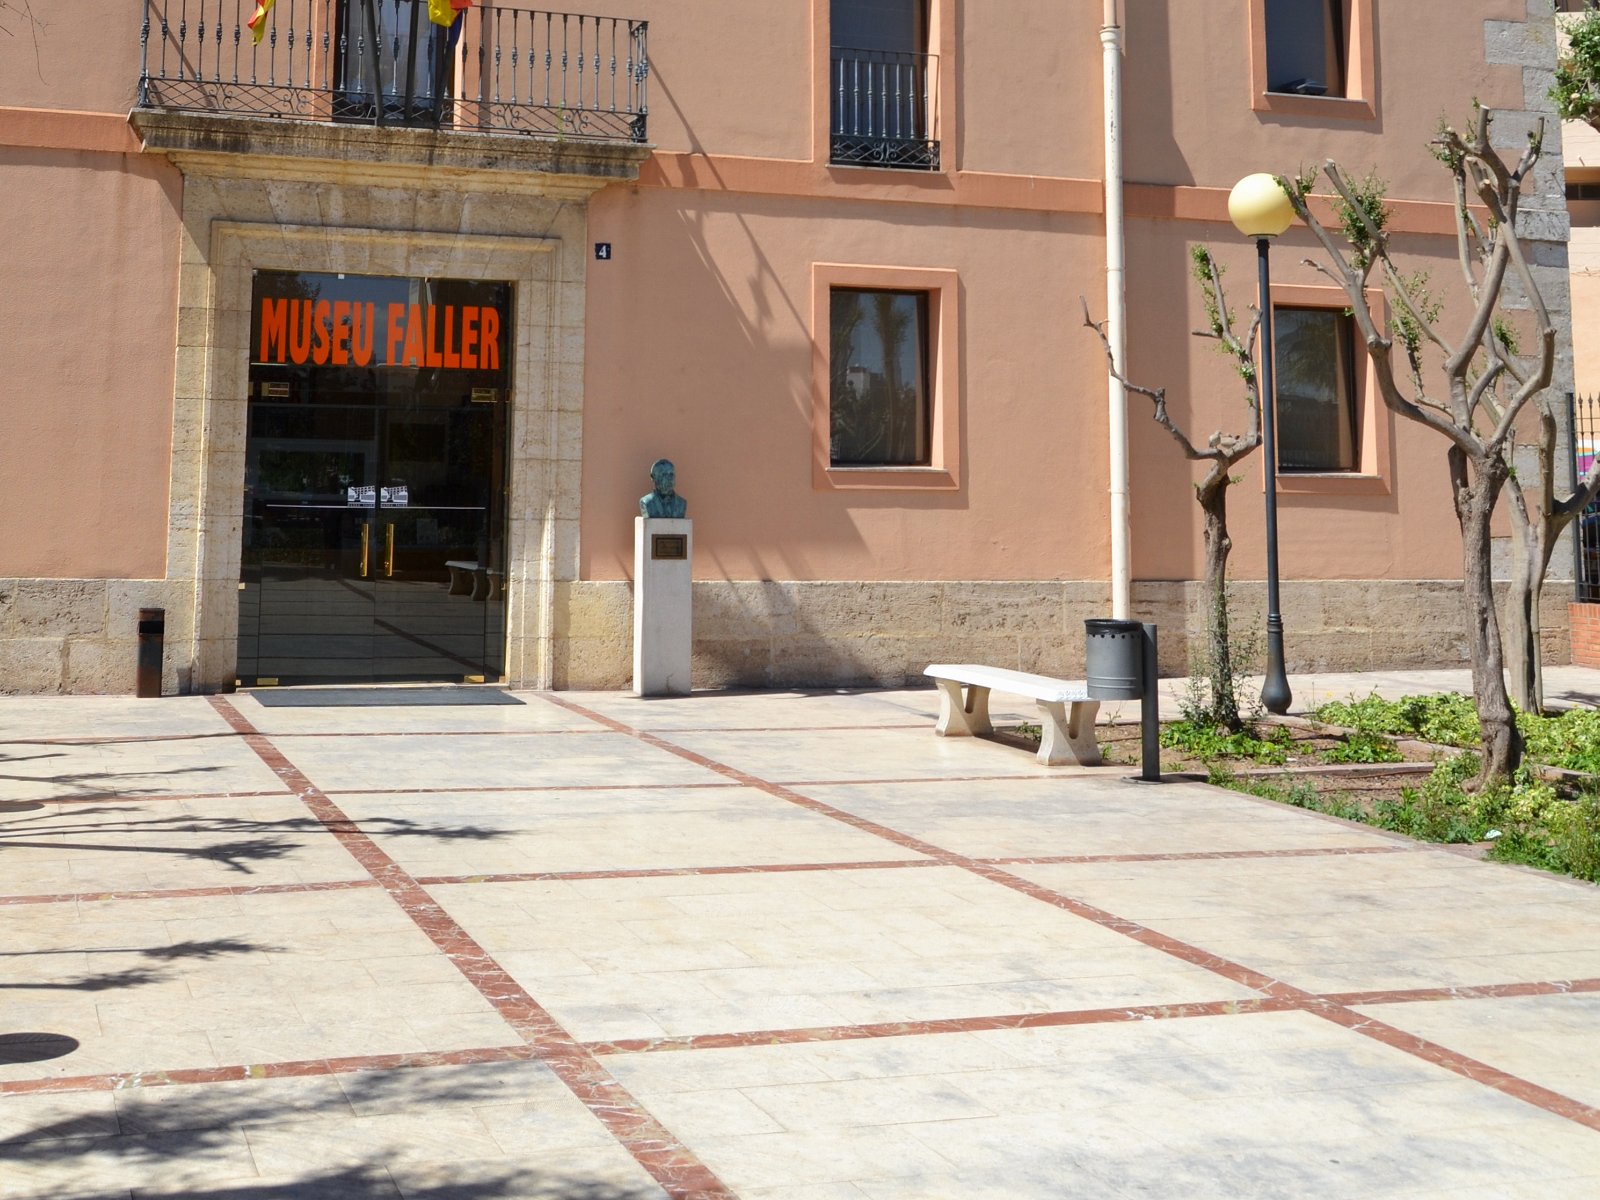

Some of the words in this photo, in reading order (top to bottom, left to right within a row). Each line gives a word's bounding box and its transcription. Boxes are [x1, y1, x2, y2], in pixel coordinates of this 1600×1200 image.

[598, 245, 606, 258] 4
[259, 297, 374, 367] MUSEU
[386, 303, 500, 370] FALLER
